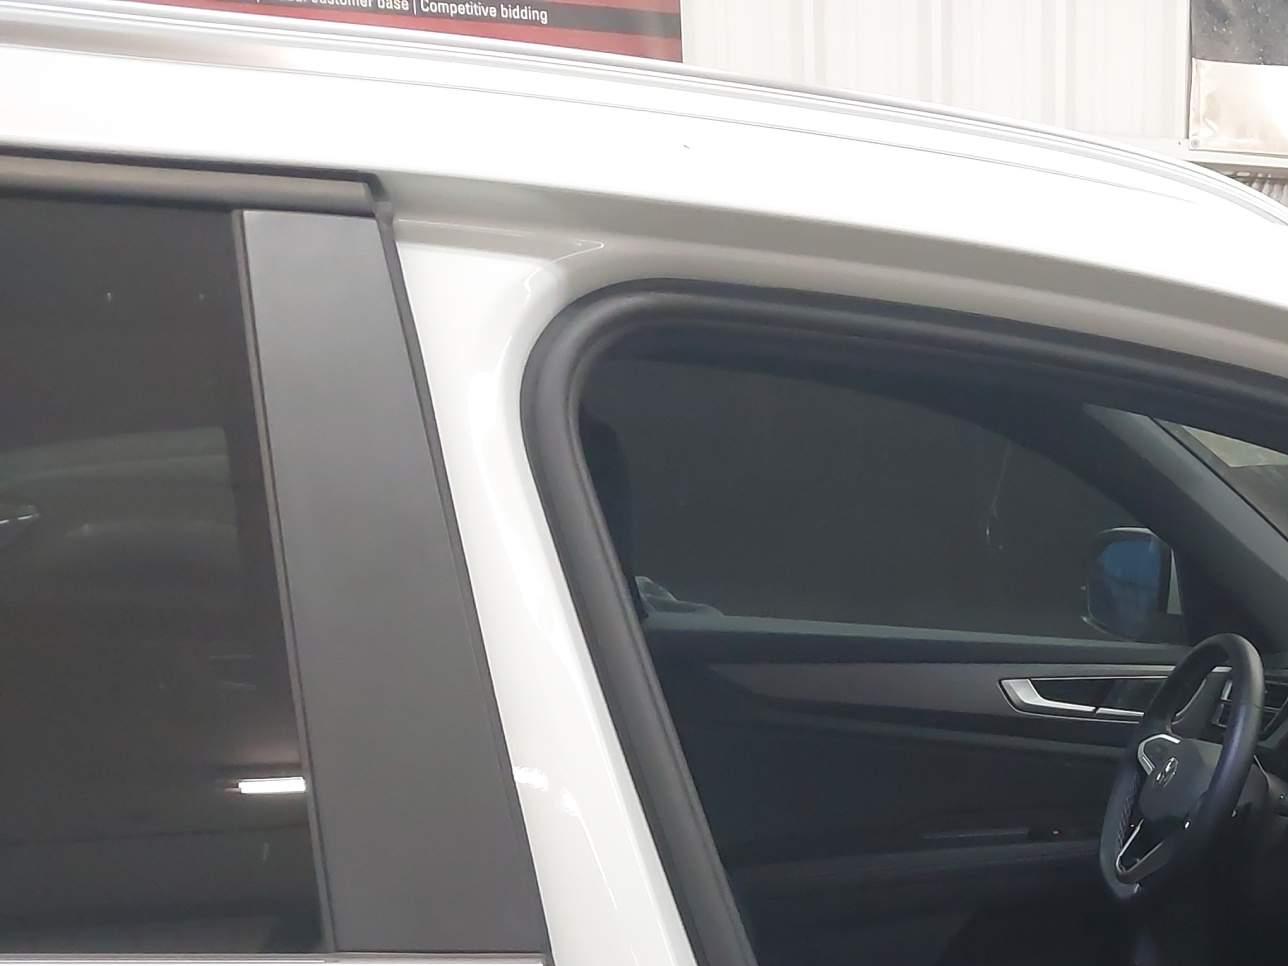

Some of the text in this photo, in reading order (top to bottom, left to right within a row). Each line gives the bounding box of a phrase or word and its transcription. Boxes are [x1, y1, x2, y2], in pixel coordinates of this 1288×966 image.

[378, 0, 409, 11] base
[420, 0, 497, 17] Competitive
[500, 4, 548, 25] bidding
